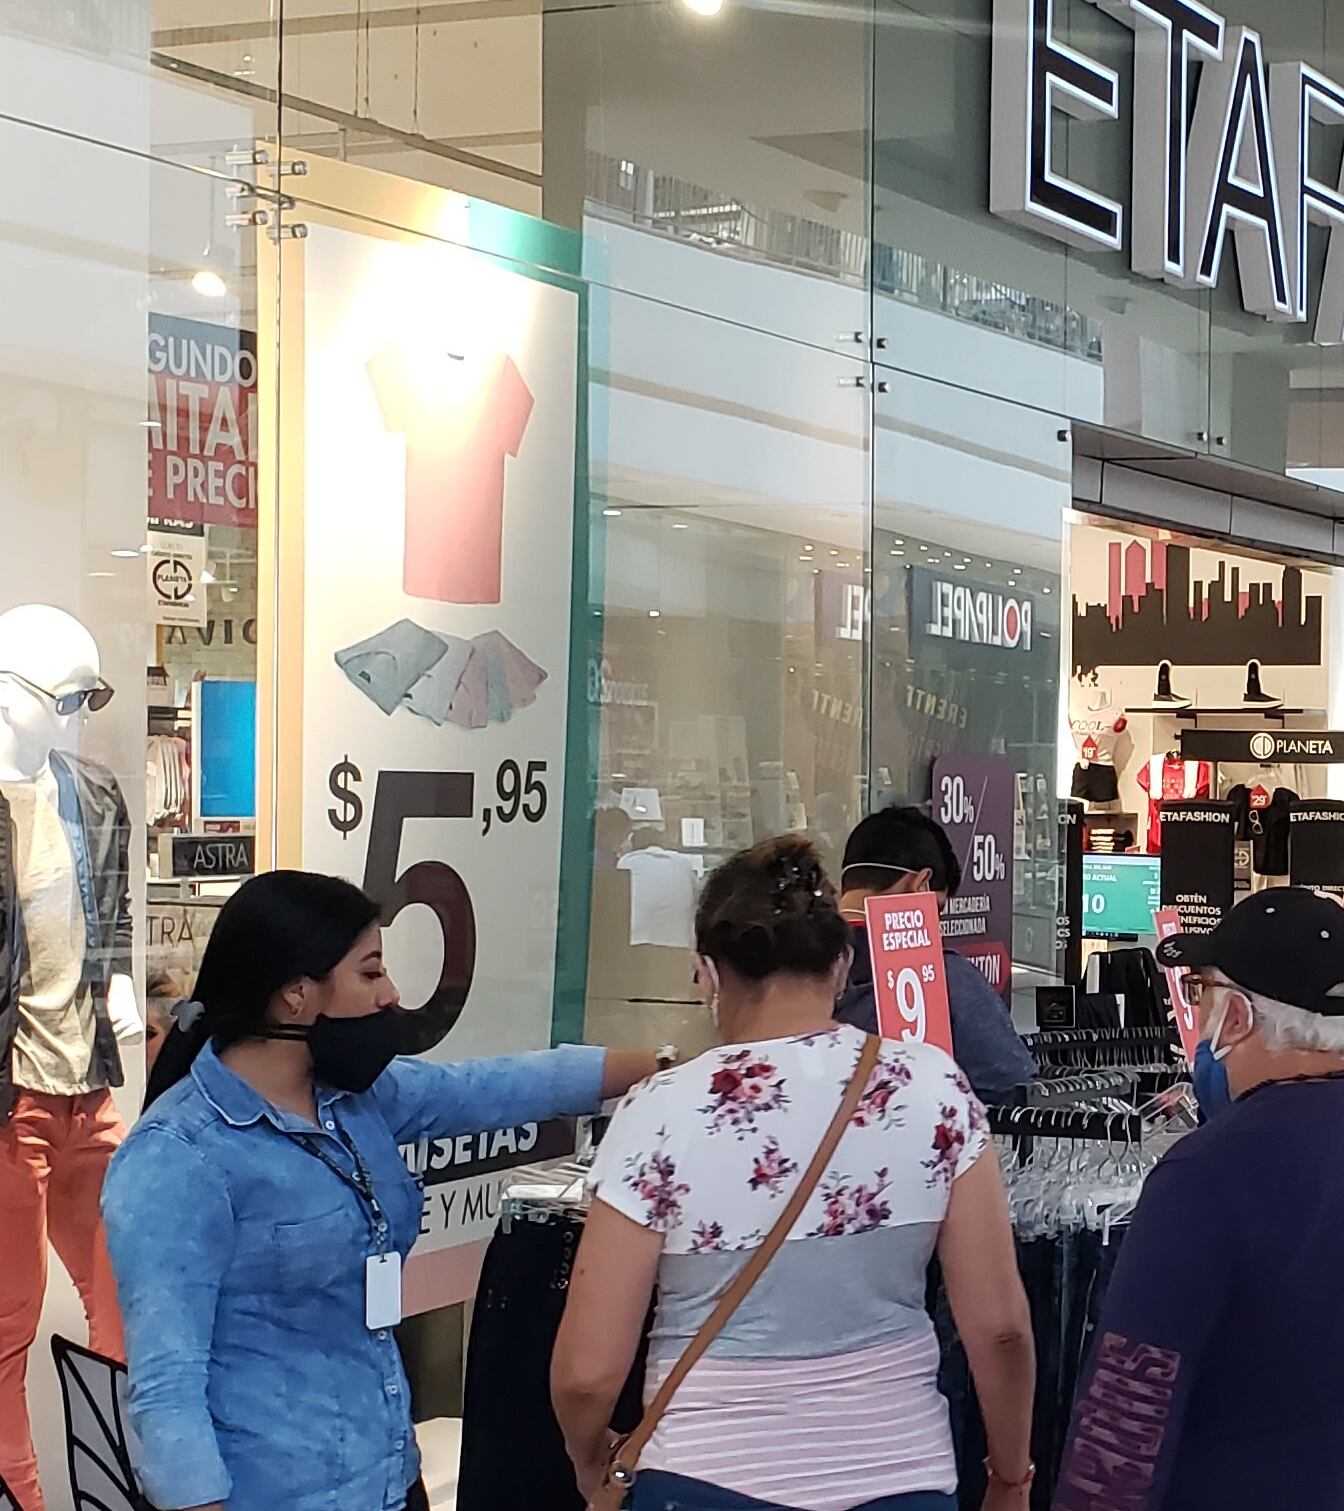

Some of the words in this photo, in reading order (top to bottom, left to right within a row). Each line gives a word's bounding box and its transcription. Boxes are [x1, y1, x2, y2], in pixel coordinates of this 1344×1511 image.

[1276, 739, 1334, 755] PLANETA
[940, 775, 974, 824] 30%
[1160, 810, 1230, 823] ETAFASHION
[193, 842, 249, 869] ASTRA
[972, 834, 1006, 881] 50%
[1175, 893, 1208, 904] OBTÉN
[884, 909, 924, 931] PRECIO
[1179, 915, 1223, 927] NEFICIOS
[882, 928, 932, 951] ESPECIAL
[440, 1190, 457, 1230] Y
